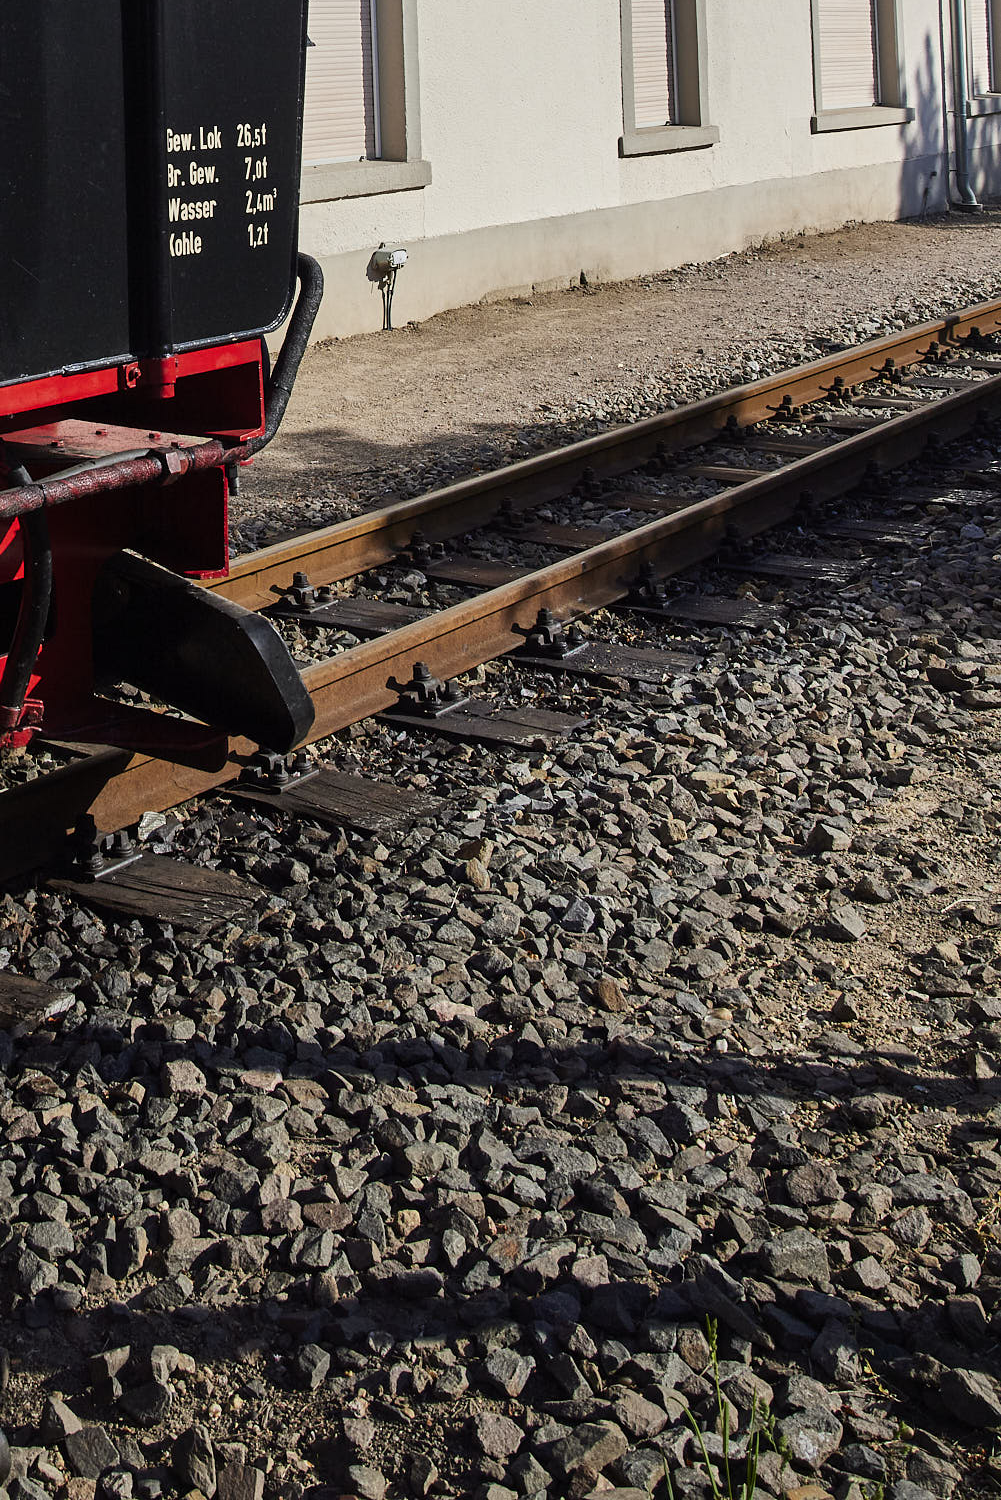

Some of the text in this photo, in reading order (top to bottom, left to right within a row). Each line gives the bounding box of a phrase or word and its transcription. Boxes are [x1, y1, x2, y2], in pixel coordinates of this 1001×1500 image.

[166, 128, 196, 152] Gew.
[199, 125, 222, 150] Lok
[167, 163, 186, 187] Br.
[189, 161, 219, 185] Gew.
[168, 197, 217, 222] Wasser
